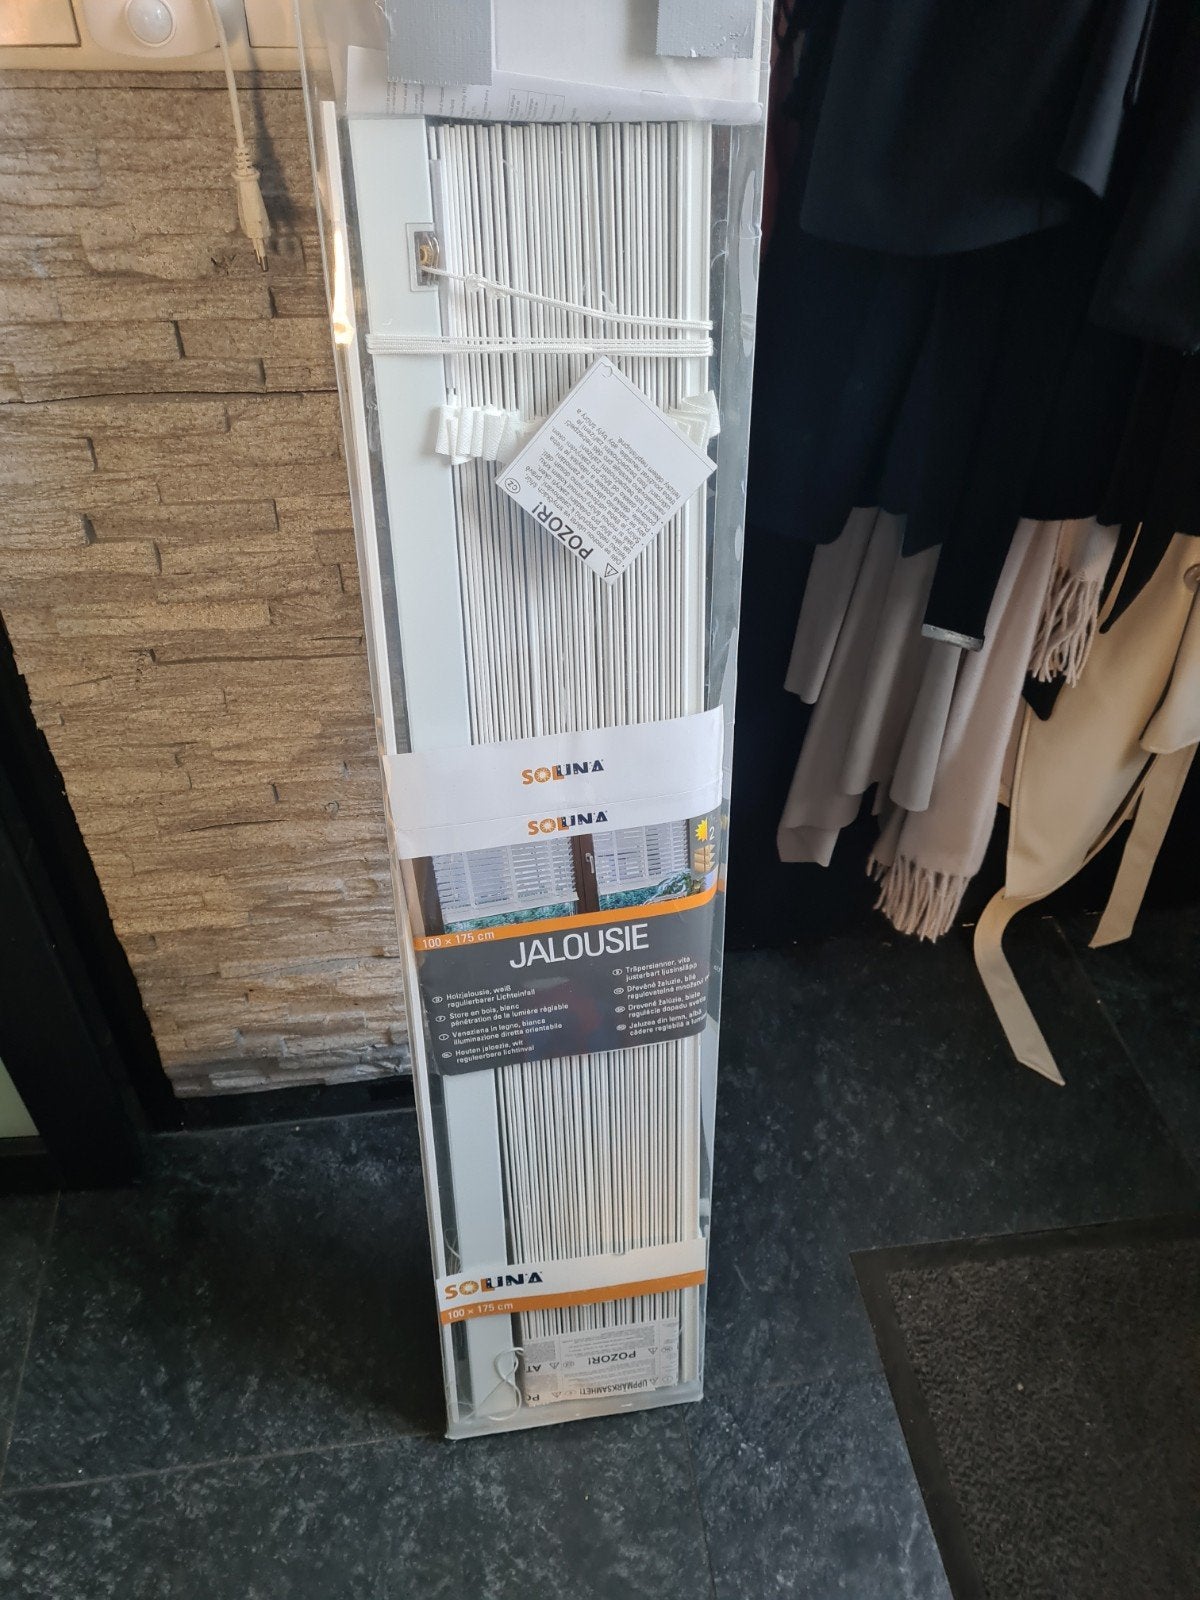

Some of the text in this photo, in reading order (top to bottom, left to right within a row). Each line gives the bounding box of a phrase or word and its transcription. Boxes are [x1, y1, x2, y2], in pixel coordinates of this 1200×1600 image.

[531, 500, 593, 560] POZOR!
[422, 937, 442, 950] 100
[455, 932, 475, 945] 175
[477, 931, 495, 942] cm
[509, 922, 650, 969] JALOUSIE
[492, 984, 511, 993] weiß
[447, 988, 535, 1009] regulierbarer Lichteinfall
[449, 1010, 468, 1019] Store
[481, 1006, 498, 1015] bois,
[447, 1309, 465, 1320] 100
[478, 1303, 495, 1314] 175
[497, 1303, 514, 1311] cm
[588, 1350, 636, 1365] POZOR!
